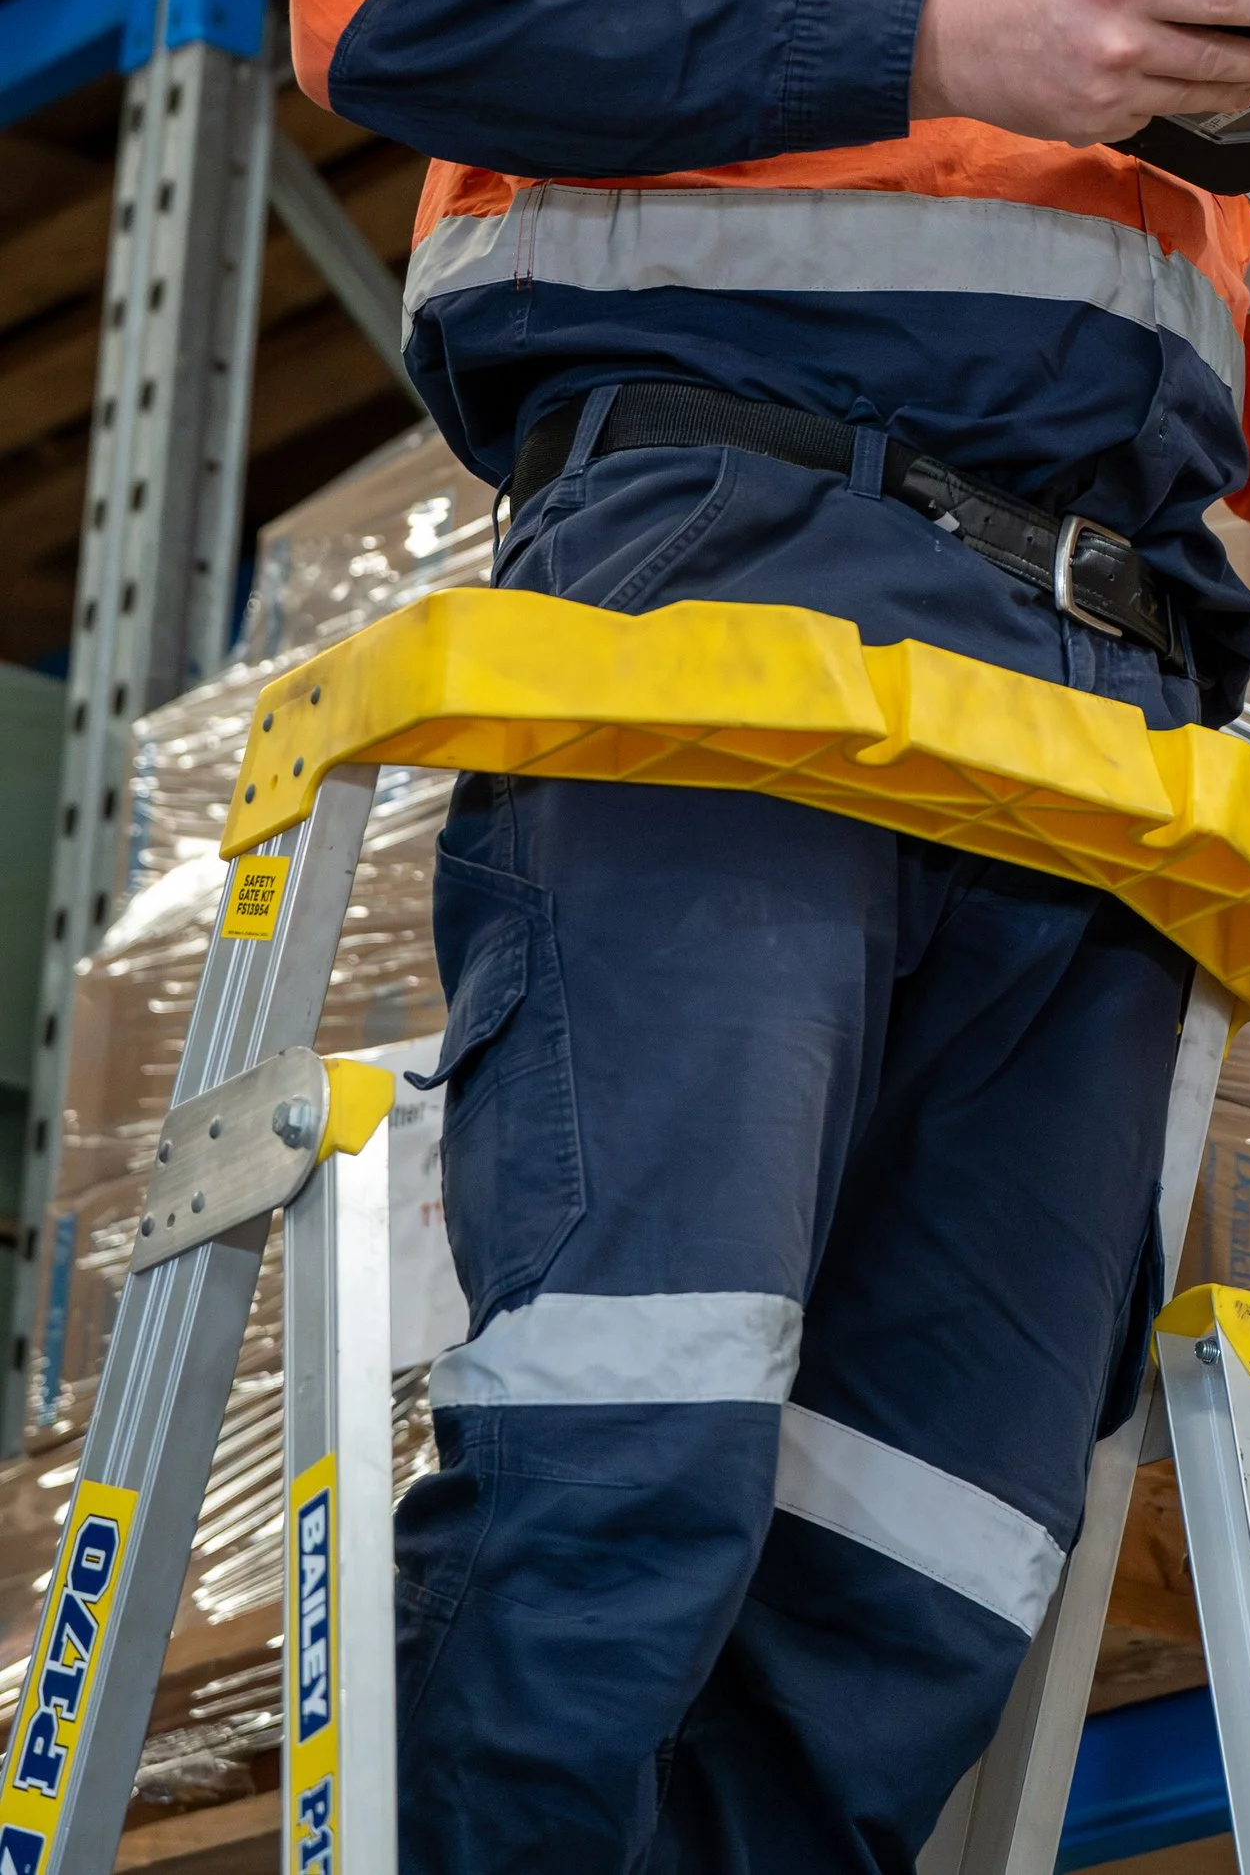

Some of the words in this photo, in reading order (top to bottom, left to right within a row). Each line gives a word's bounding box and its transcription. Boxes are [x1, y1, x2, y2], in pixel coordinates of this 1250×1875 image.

[238, 889, 259, 902] GATE
[260, 890, 275, 902] KIT
[244, 874, 276, 888] SAFETY
[13, 1514, 120, 1799] P170
[301, 1503, 328, 1719] BAILEY
[298, 1773, 333, 1875] P1
